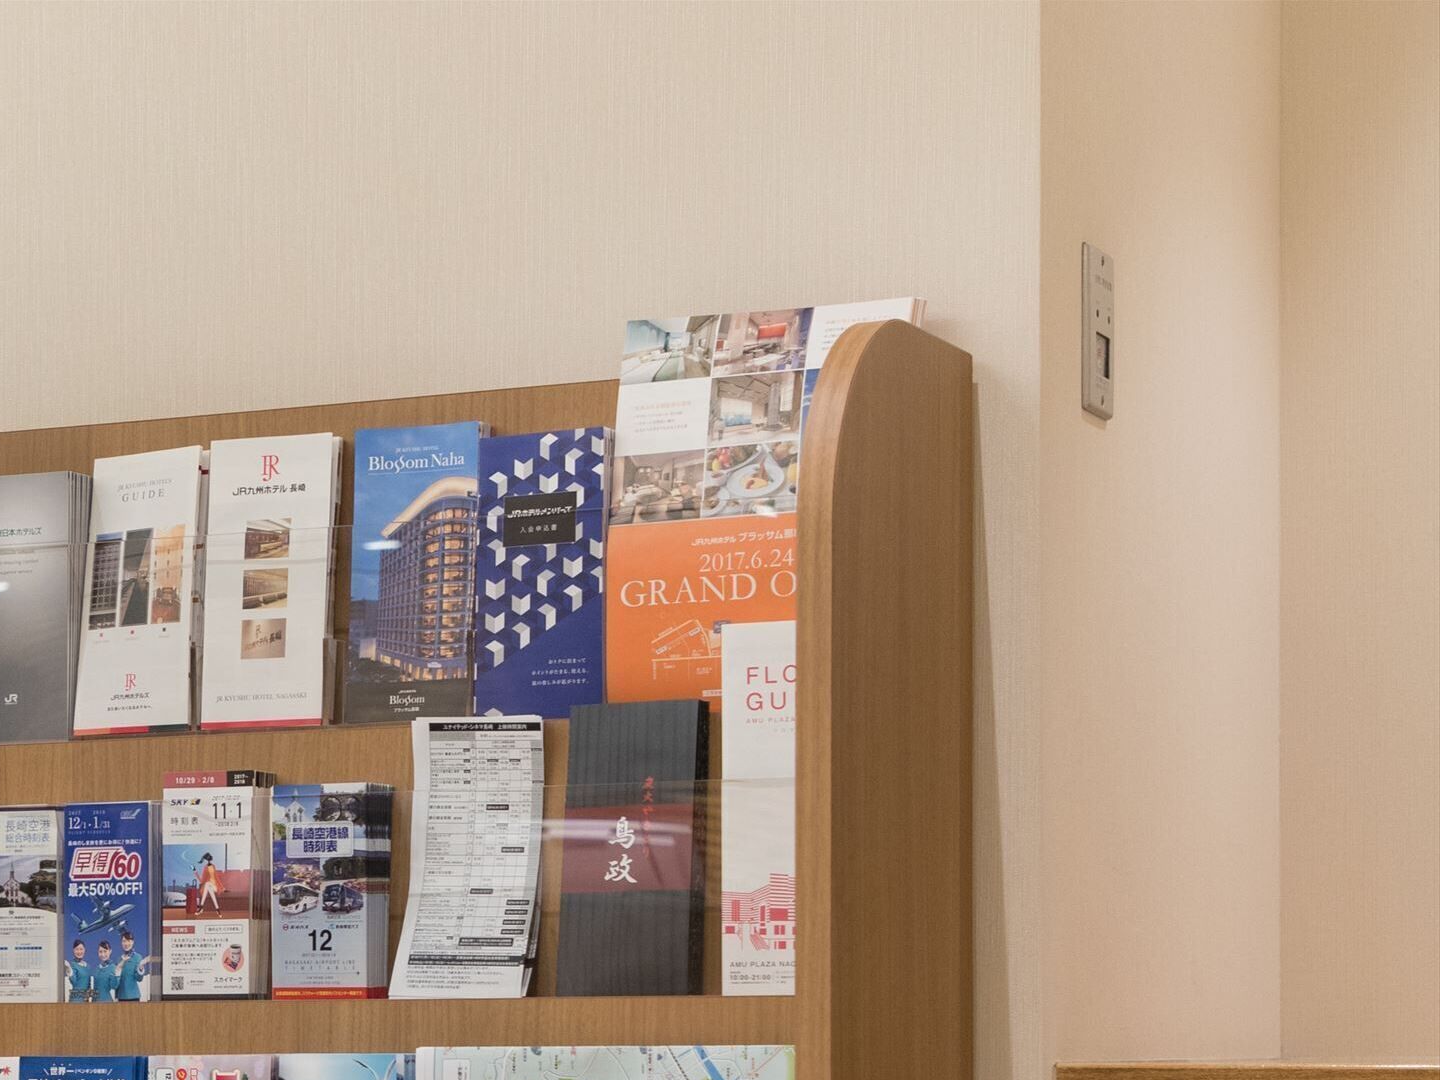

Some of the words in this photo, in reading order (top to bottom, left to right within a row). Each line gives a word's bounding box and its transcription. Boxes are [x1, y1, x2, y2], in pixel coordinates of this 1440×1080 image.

[431, 455, 465, 469] Naha
[232, 486, 287, 496] JR九州ホテル
[290, 483, 306, 492] 長崎
[121, 493, 165, 502] GUIDE
[699, 548, 795, 572] 2017.6.24
[620, 576, 757, 608] GRAND
[292, 827, 349, 841] 長崎空港線
[303, 841, 338, 853] 時刻表
[308, 929, 333, 951] 12
